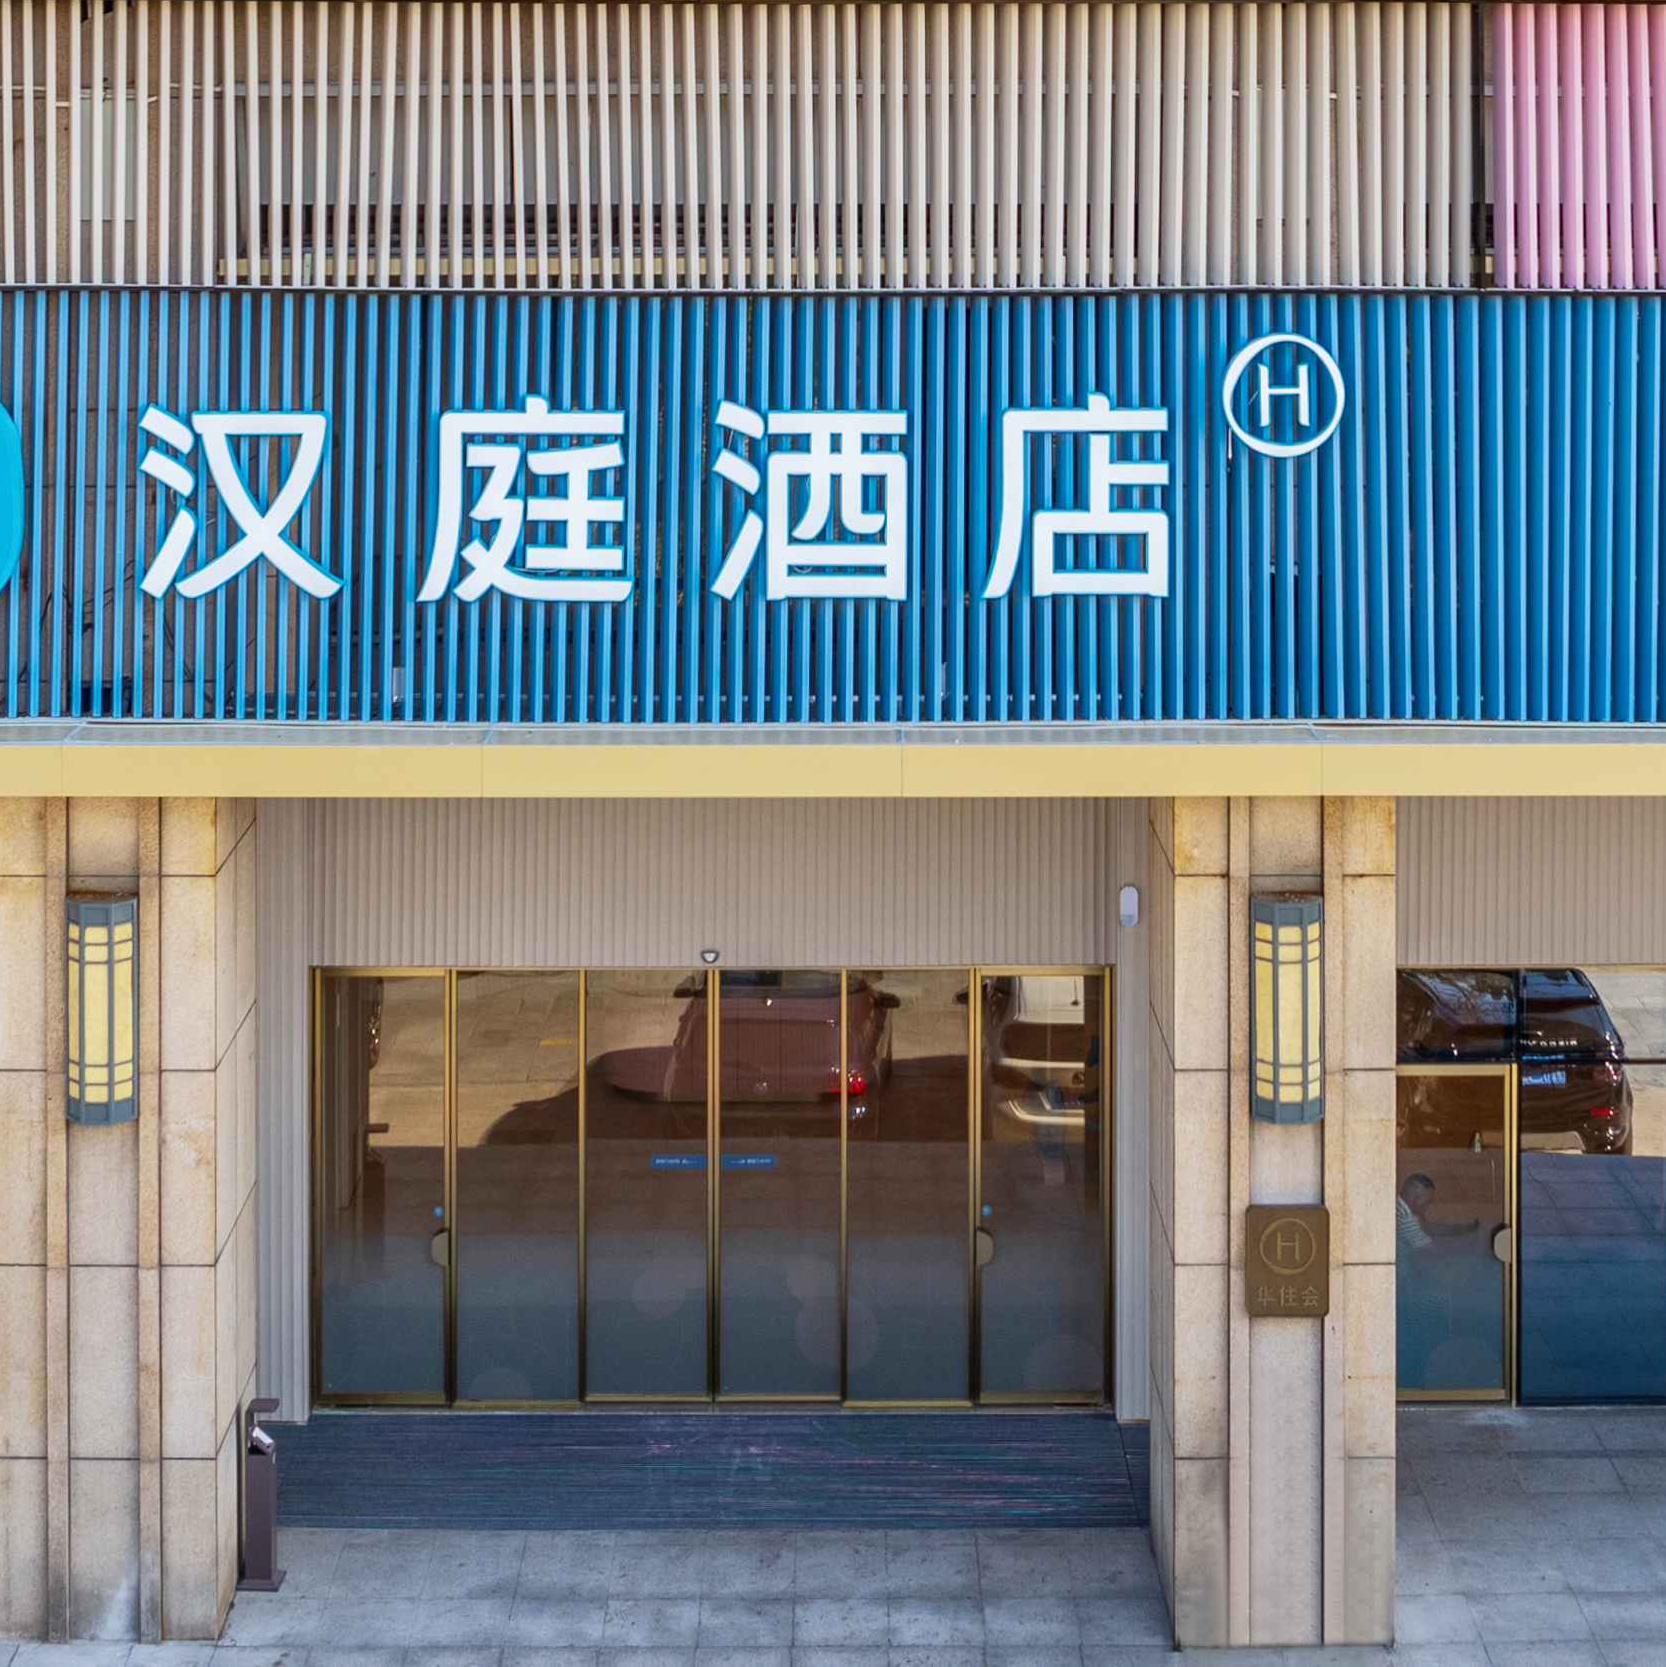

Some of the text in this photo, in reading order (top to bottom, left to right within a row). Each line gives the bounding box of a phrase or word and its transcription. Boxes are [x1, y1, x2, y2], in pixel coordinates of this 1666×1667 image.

[139, 394, 1169, 603] 汉庭酒店
[1257, 1285, 1319, 1308] 华住会
